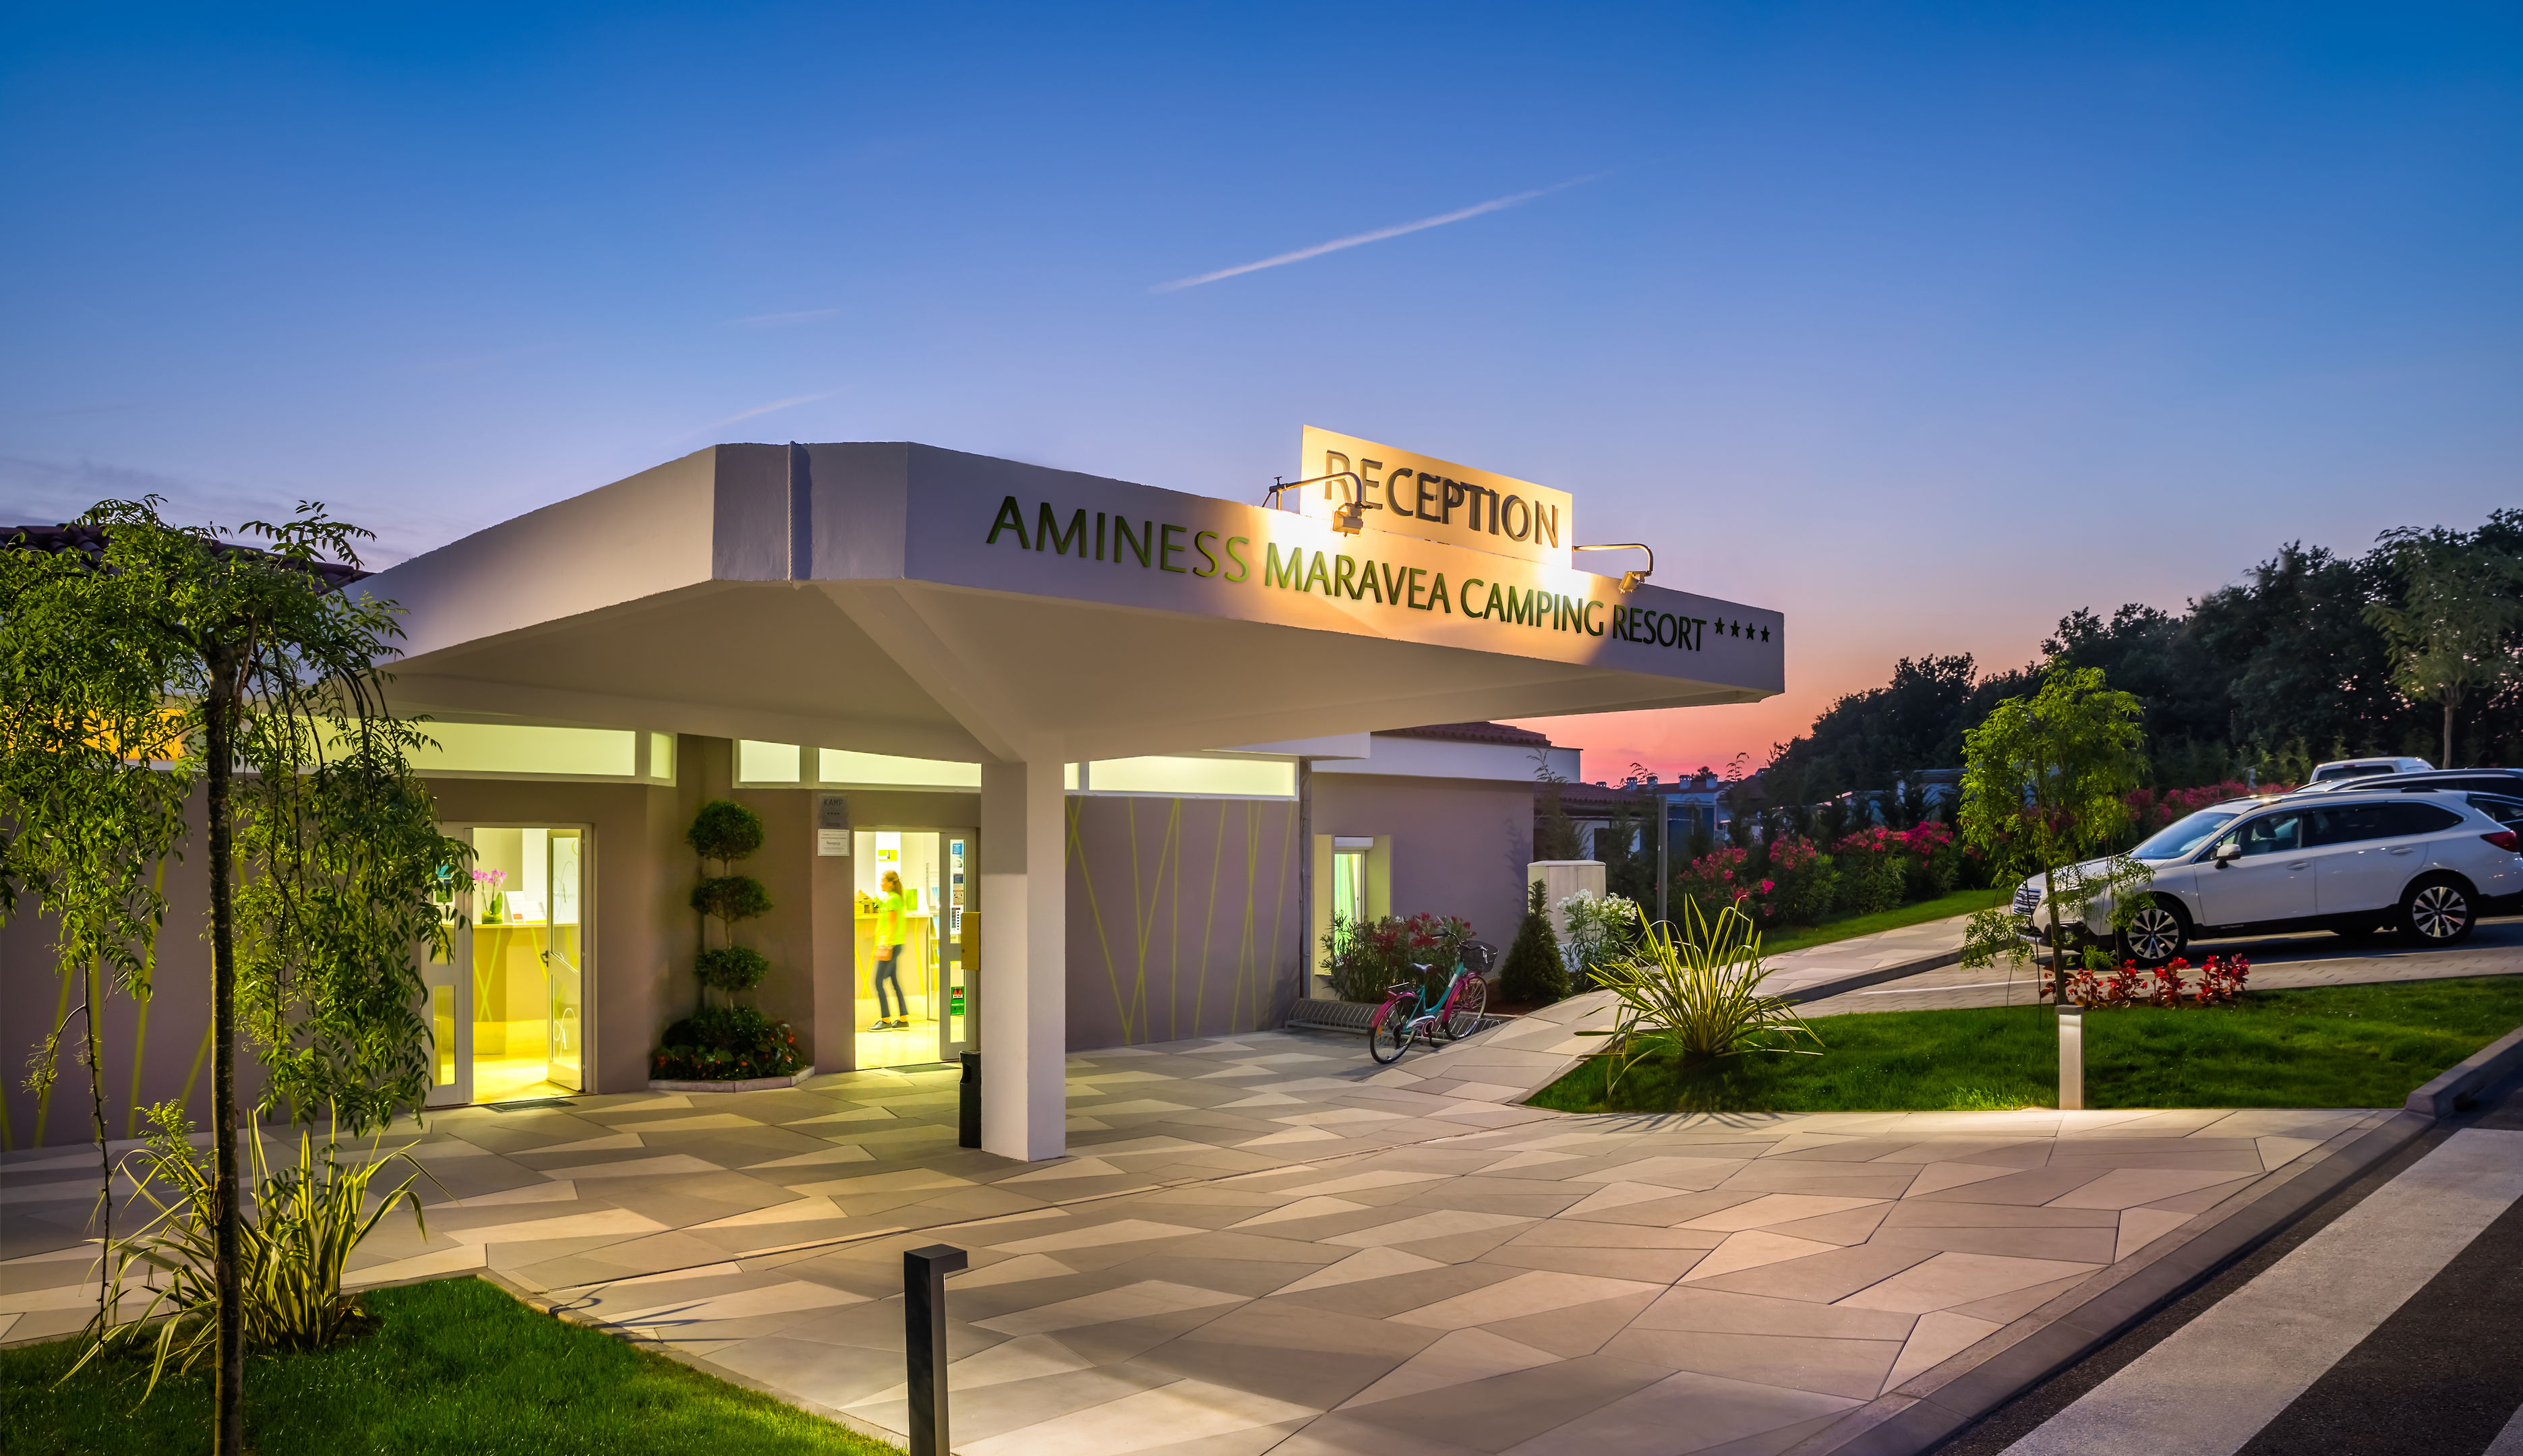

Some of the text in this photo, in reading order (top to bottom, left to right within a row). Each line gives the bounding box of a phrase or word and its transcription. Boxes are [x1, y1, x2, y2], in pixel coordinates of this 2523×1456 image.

[1324, 450, 1558, 548] RECEPTION
[986, 495, 1706, 651] AMINESS MARAVEA CAMPING RESORT
[824, 798, 843, 806] KAMP
